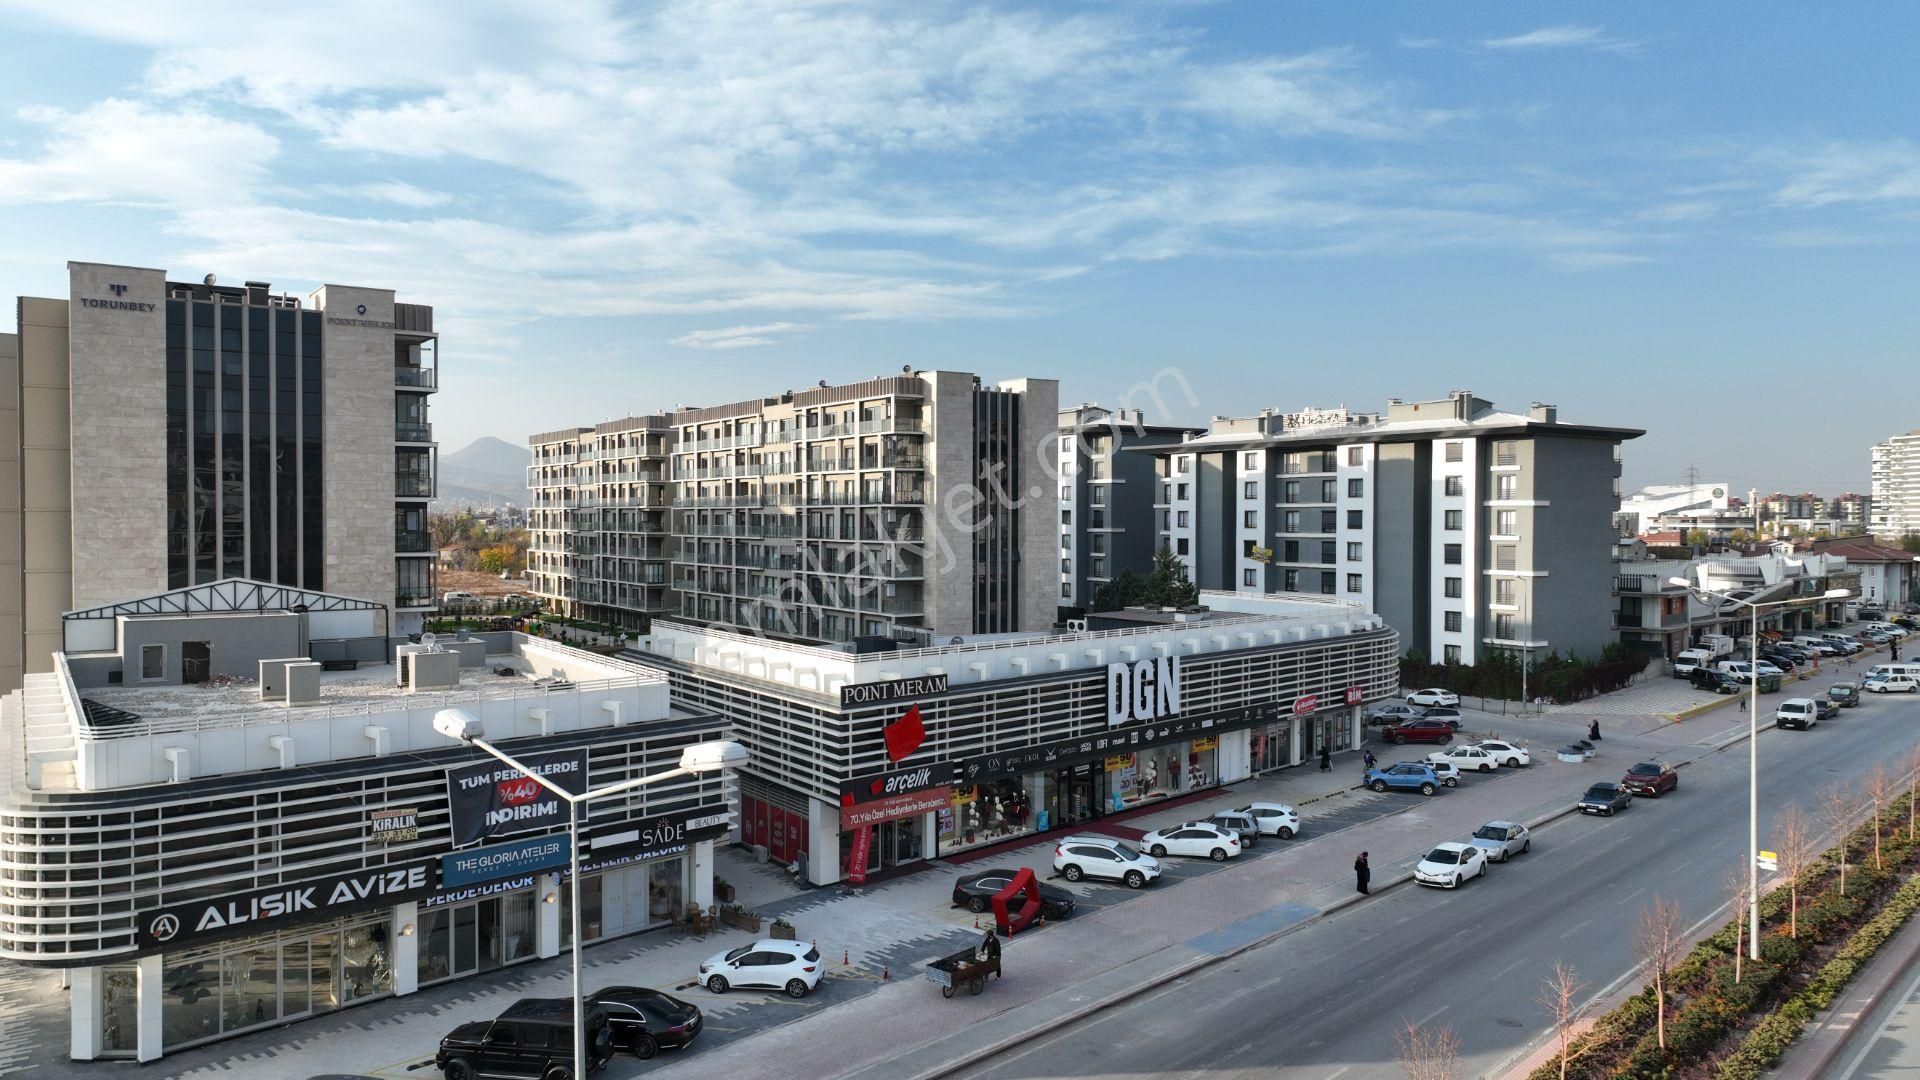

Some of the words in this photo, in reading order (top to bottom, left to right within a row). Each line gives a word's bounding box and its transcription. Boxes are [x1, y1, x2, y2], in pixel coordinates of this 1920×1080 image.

[80, 297, 155, 312] TORUNBEY
[844, 683, 890, 704] POINT
[892, 677, 947, 698] MERAM
[1108, 656, 1180, 726] DGN
[500, 781, 537, 803] %40
[885, 768, 932, 794] arçelik
[694, 815, 722, 829] BEAUTY
[456, 858, 478, 872] THE
[479, 851, 520, 867] GLORIA
[520, 843, 560, 860] ATELIER
